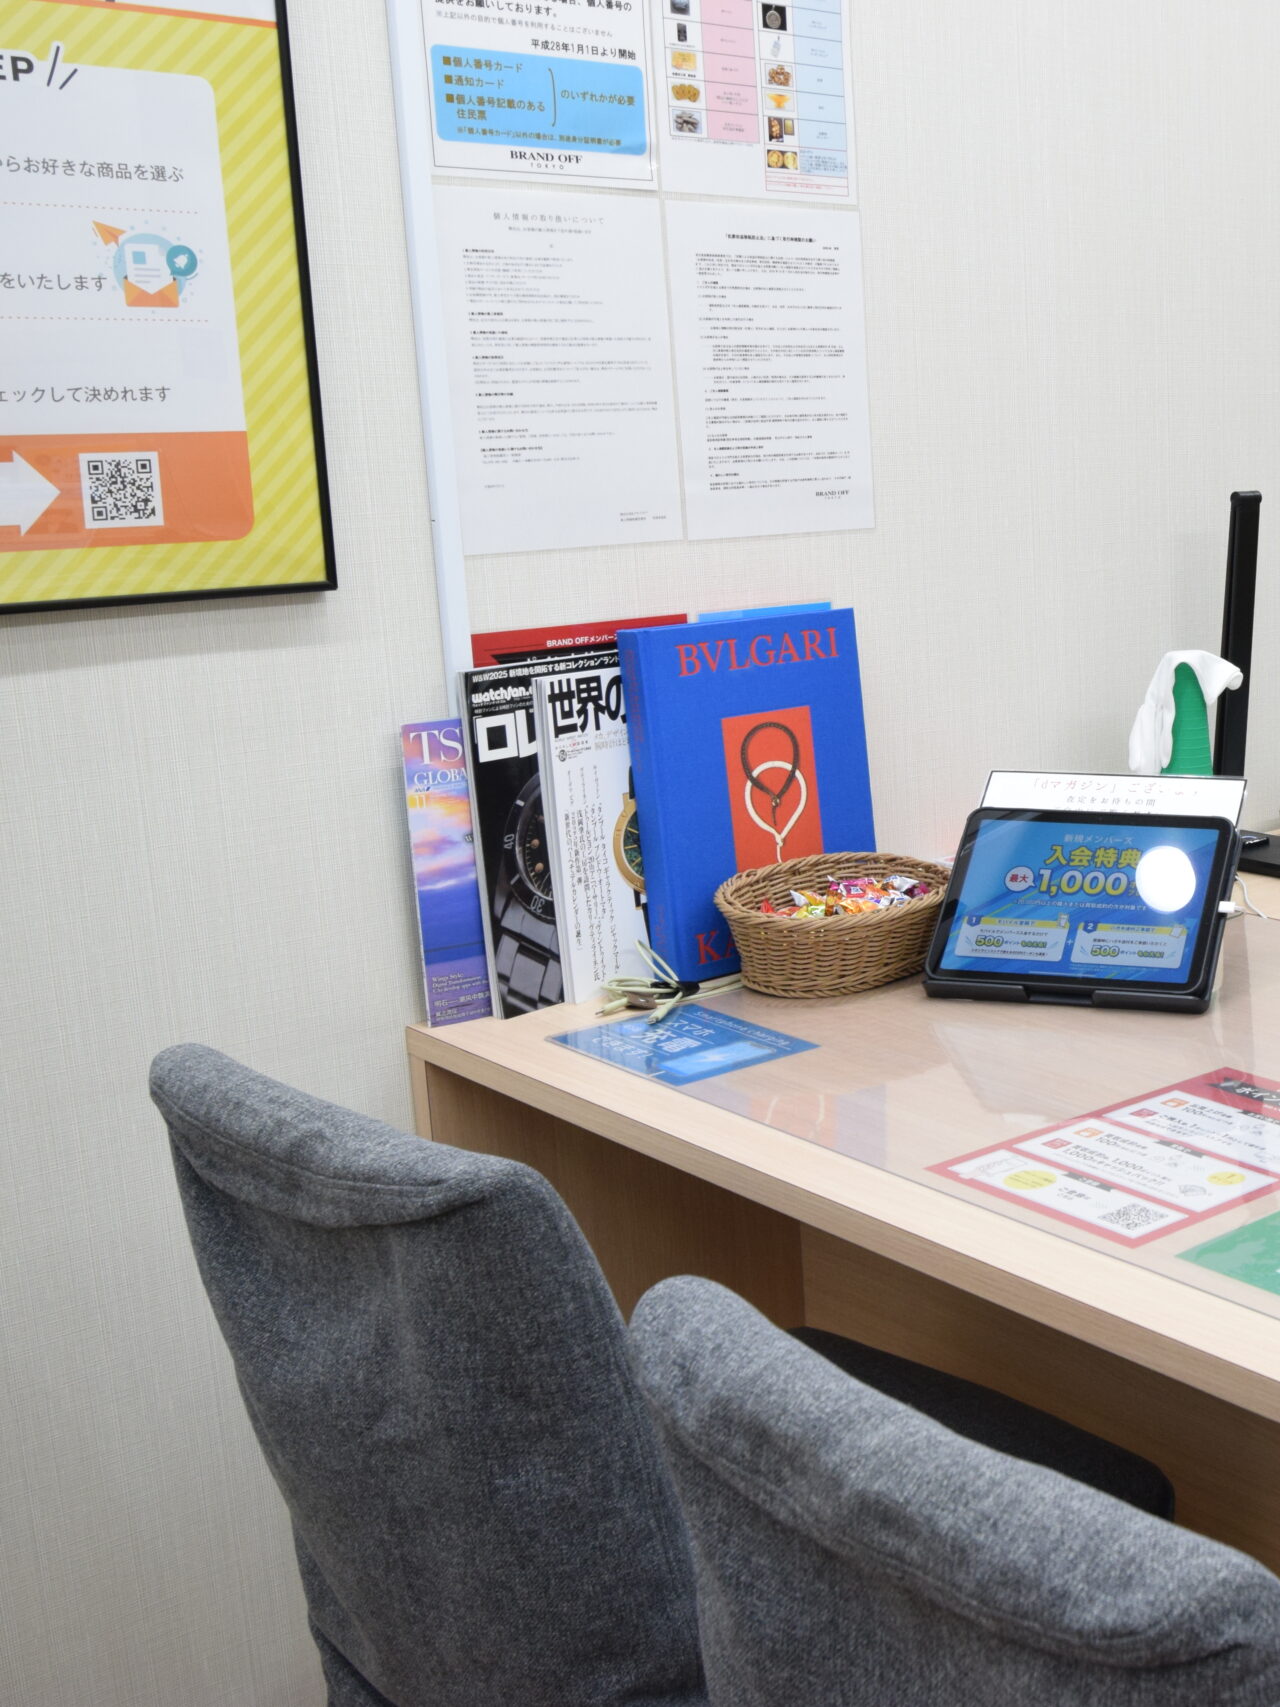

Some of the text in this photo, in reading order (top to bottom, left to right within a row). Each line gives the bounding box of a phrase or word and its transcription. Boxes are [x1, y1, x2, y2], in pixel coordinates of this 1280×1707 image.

[531, 39, 636, 60] 平成28年1月1日より開始
[560, 89, 636, 107] のいずれかが必要
[457, 109, 487, 120] 住民票
[510, 150, 583, 164] BRAND OFF
[0, 155, 184, 182] らお好きな商品を選ぶ
[0, 273, 107, 291] をいたします
[546, 637, 574, 648] BRAND
[674, 627, 840, 677] BVLGARI
[472, 671, 508, 683] W&W2025
[1066, 796, 1156, 807] 査定をお待ちの間
[1064, 833, 1135, 845] 新規メンバーズ
[1045, 845, 1142, 869] 入会特典
[1009, 873, 1029, 883] 最大
[1038, 868, 1128, 896] 1,000
[975, 935, 1004, 947] 500
[1090, 945, 1120, 957] 500
[669, 1019, 716, 1037] スマホ
[634, 1029, 702, 1053] 充電
